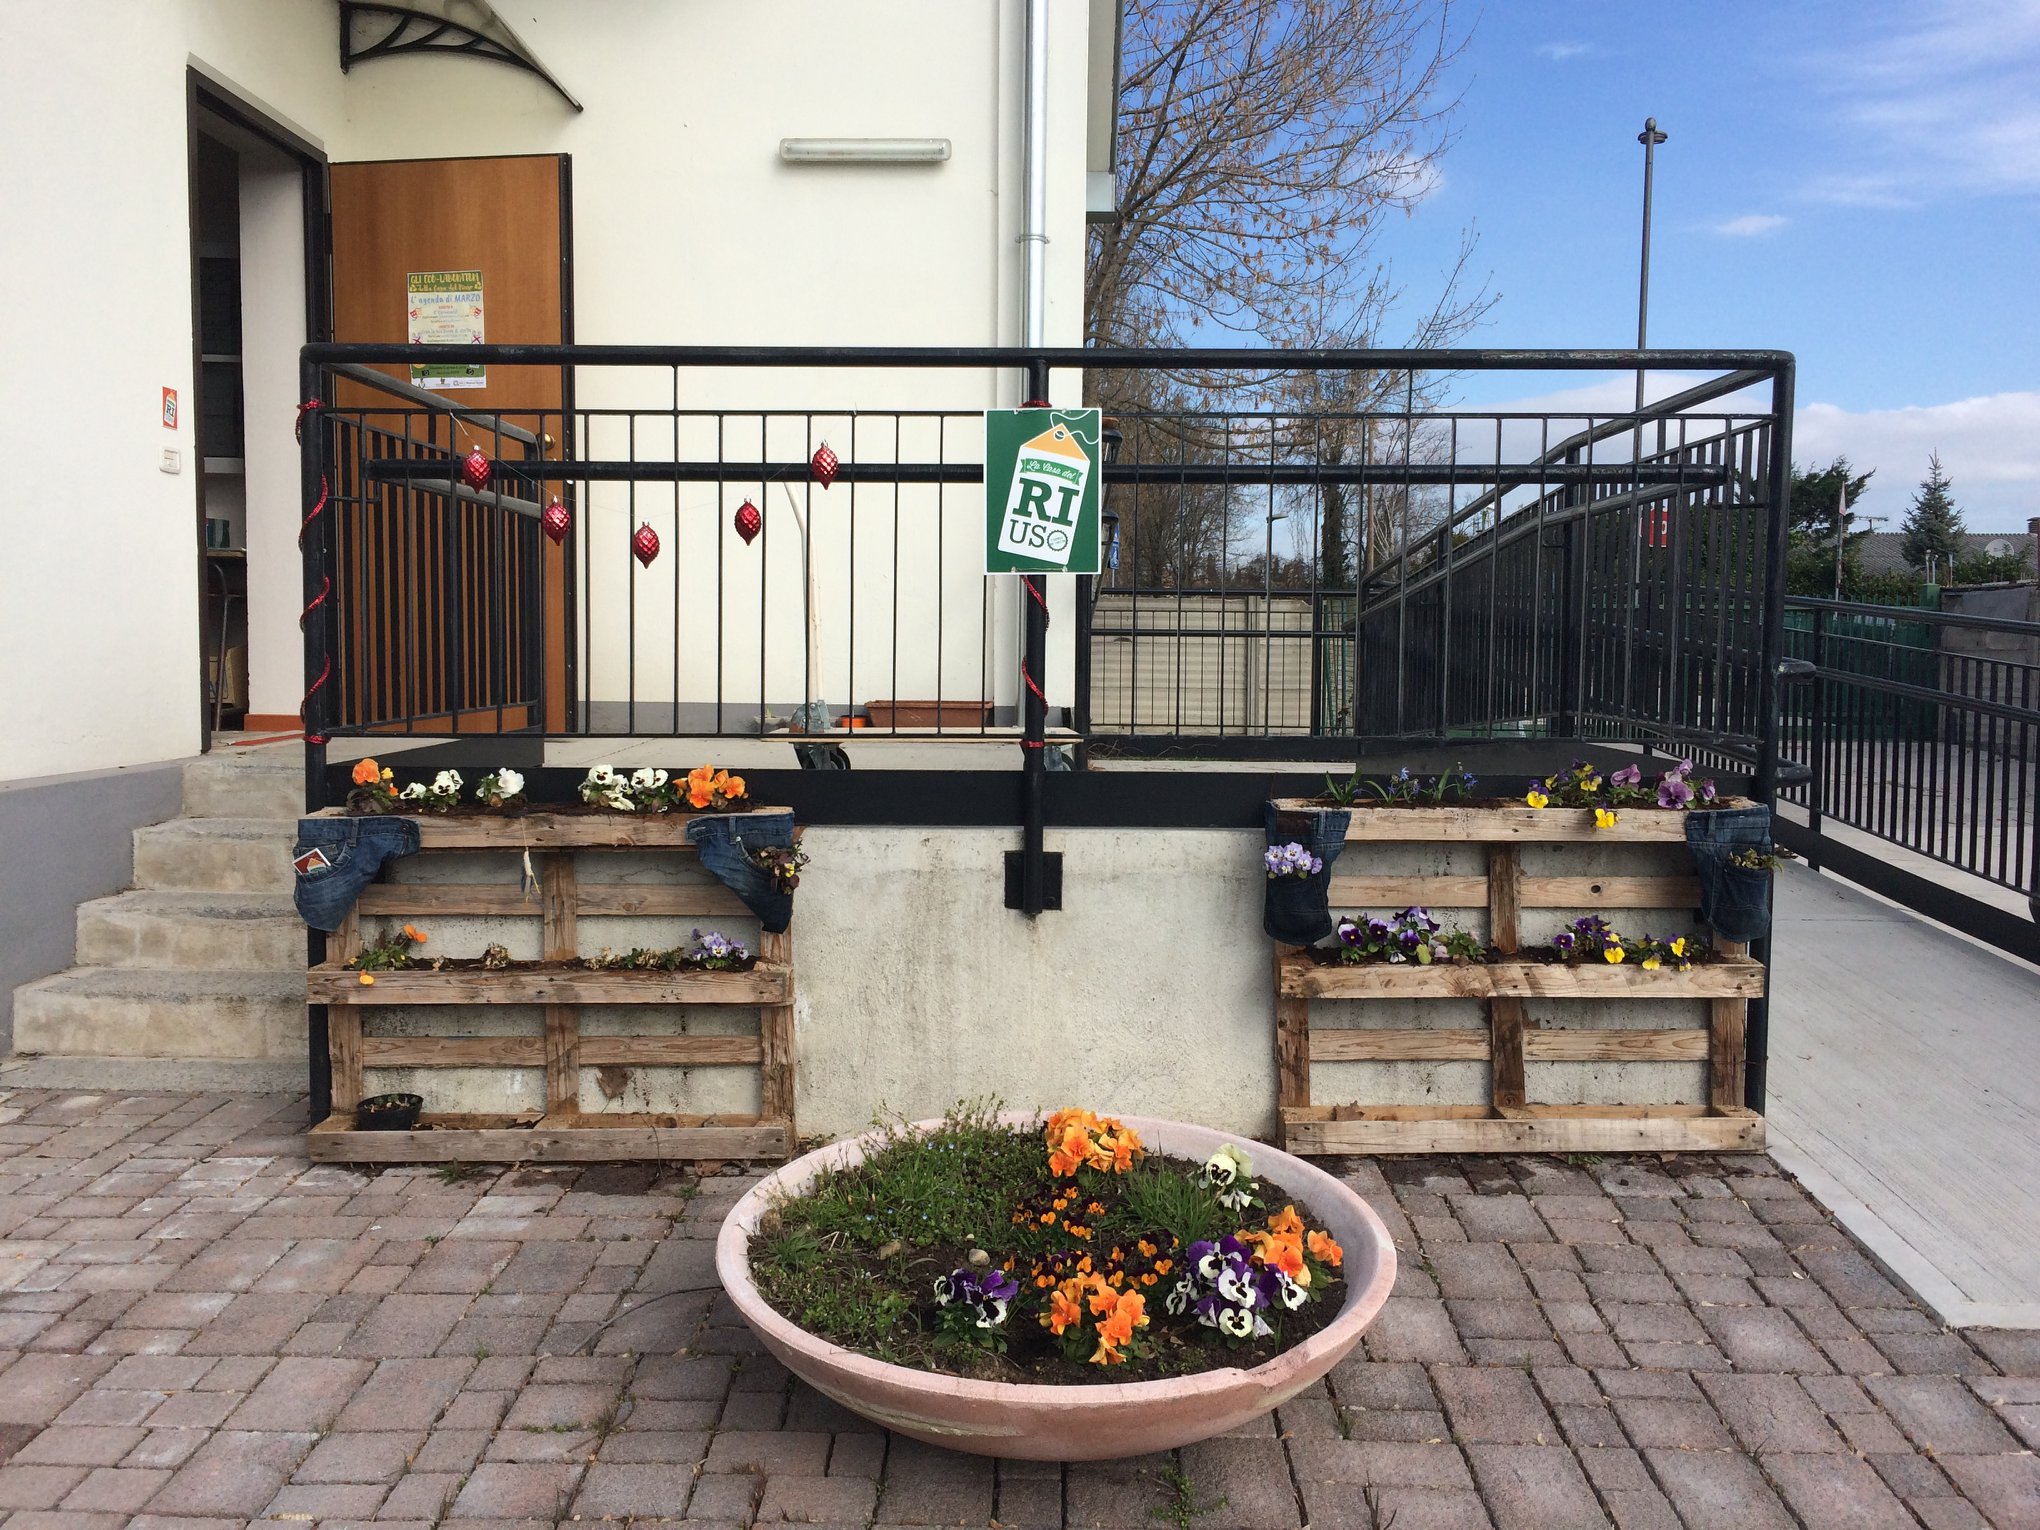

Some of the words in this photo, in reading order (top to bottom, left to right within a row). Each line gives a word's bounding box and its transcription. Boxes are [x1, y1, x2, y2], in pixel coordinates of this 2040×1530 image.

[410, 275, 422, 284] GLI
[419, 294, 444, 305] agenda
[445, 294, 452, 302] di
[454, 293, 481, 303] MARZO
[1026, 459, 1041, 472] La
[1042, 462, 1061, 475] Casa
[1061, 466, 1076, 480] del
[1012, 477, 1080, 527] RI
